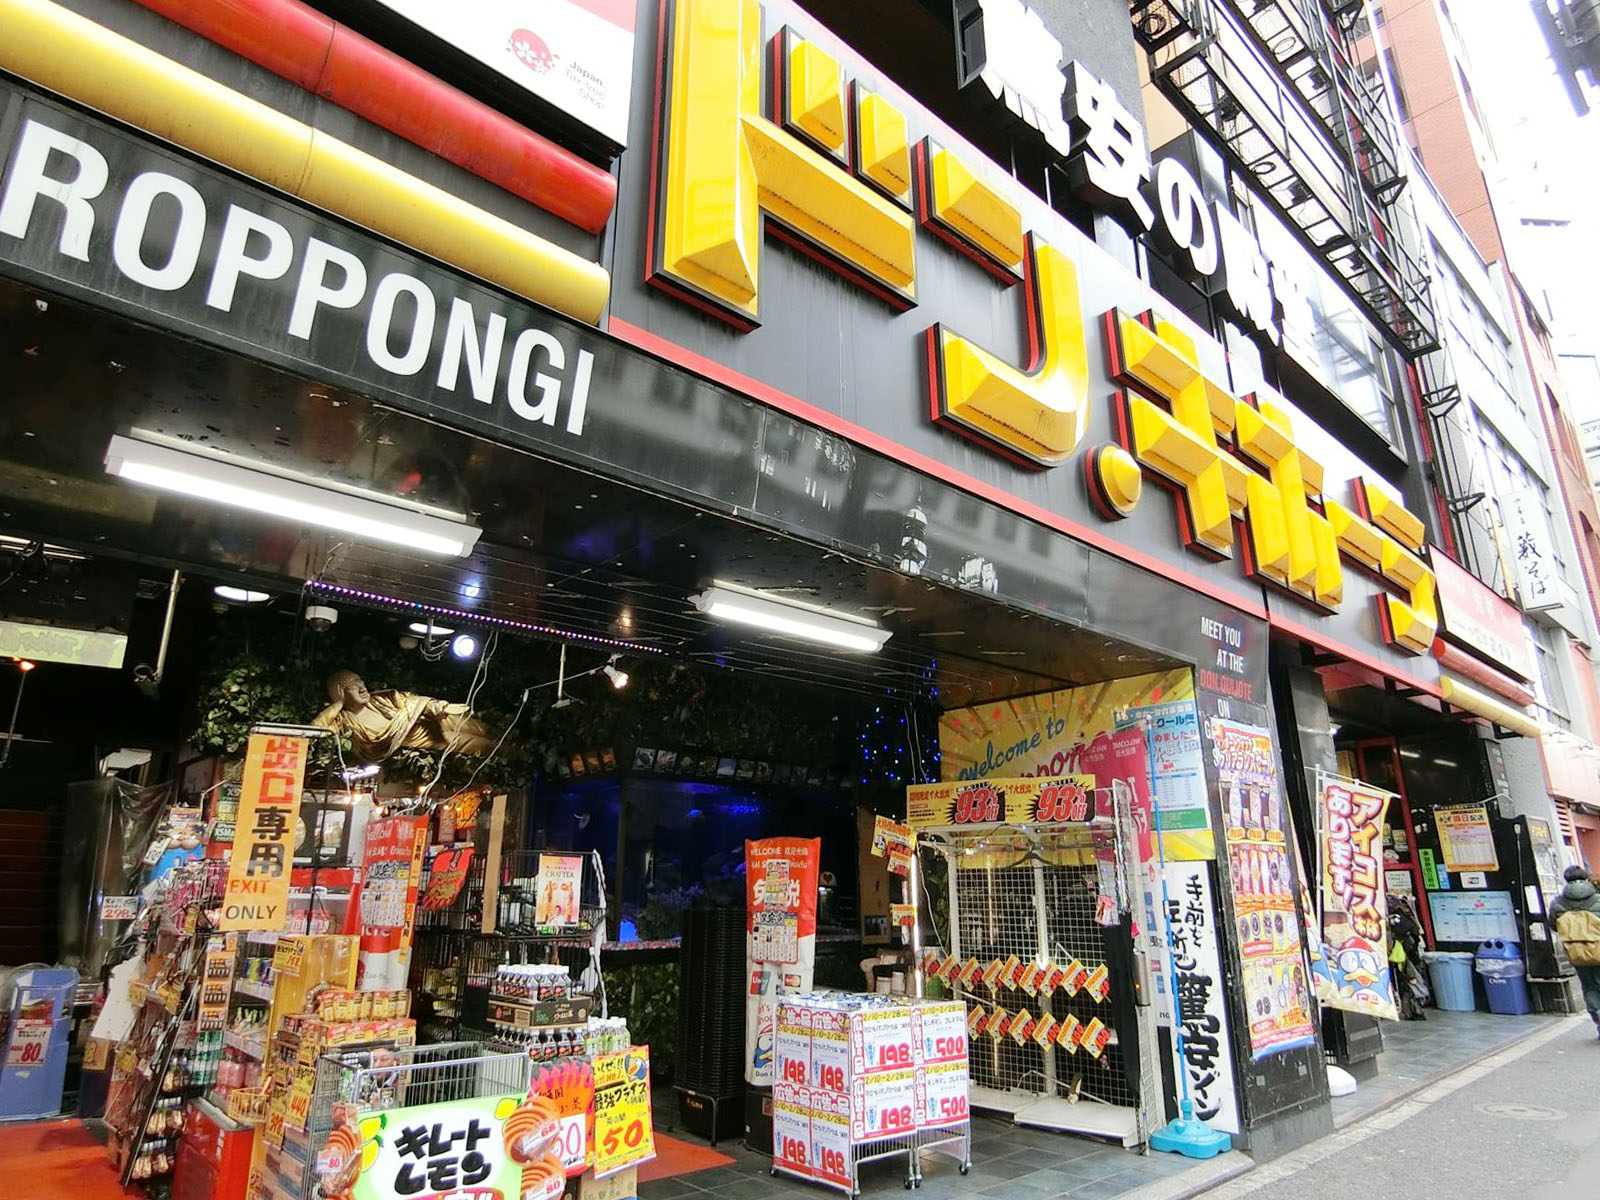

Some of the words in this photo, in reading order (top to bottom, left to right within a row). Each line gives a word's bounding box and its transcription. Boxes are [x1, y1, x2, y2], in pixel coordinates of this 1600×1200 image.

[2, 119, 594, 436] ROPPONGI
[1201, 617, 1222, 640] MEET
[1224, 625, 1241, 648] YOU
[1217, 649, 1228, 668] AT
[1229, 653, 1243, 673] THE
[1218, 699, 1230, 718] ON
[959, 732, 1042, 780] welcome
[1046, 717, 1064, 740] to
[246, 738, 300, 878] 出口専用
[1071, 802, 1087, 821] OFF
[230, 879, 270, 894] EXIT
[225, 904, 278, 920] ONLY
[21, 1042, 41, 1062] 80
[879, 1043, 910, 1065] 198
[936, 1036, 965, 1056] 500
[784, 1057, 805, 1085] 198
[821, 1063, 844, 1092] 198
[881, 1105, 912, 1129] 198
[941, 1096, 966, 1117] 500
[394, 1119, 491, 1160] キレート
[603, 1120, 644, 1155] 50
[783, 1135, 806, 1165] 198
[394, 1151, 492, 1195] レモン
[821, 1146, 846, 1176] 198
